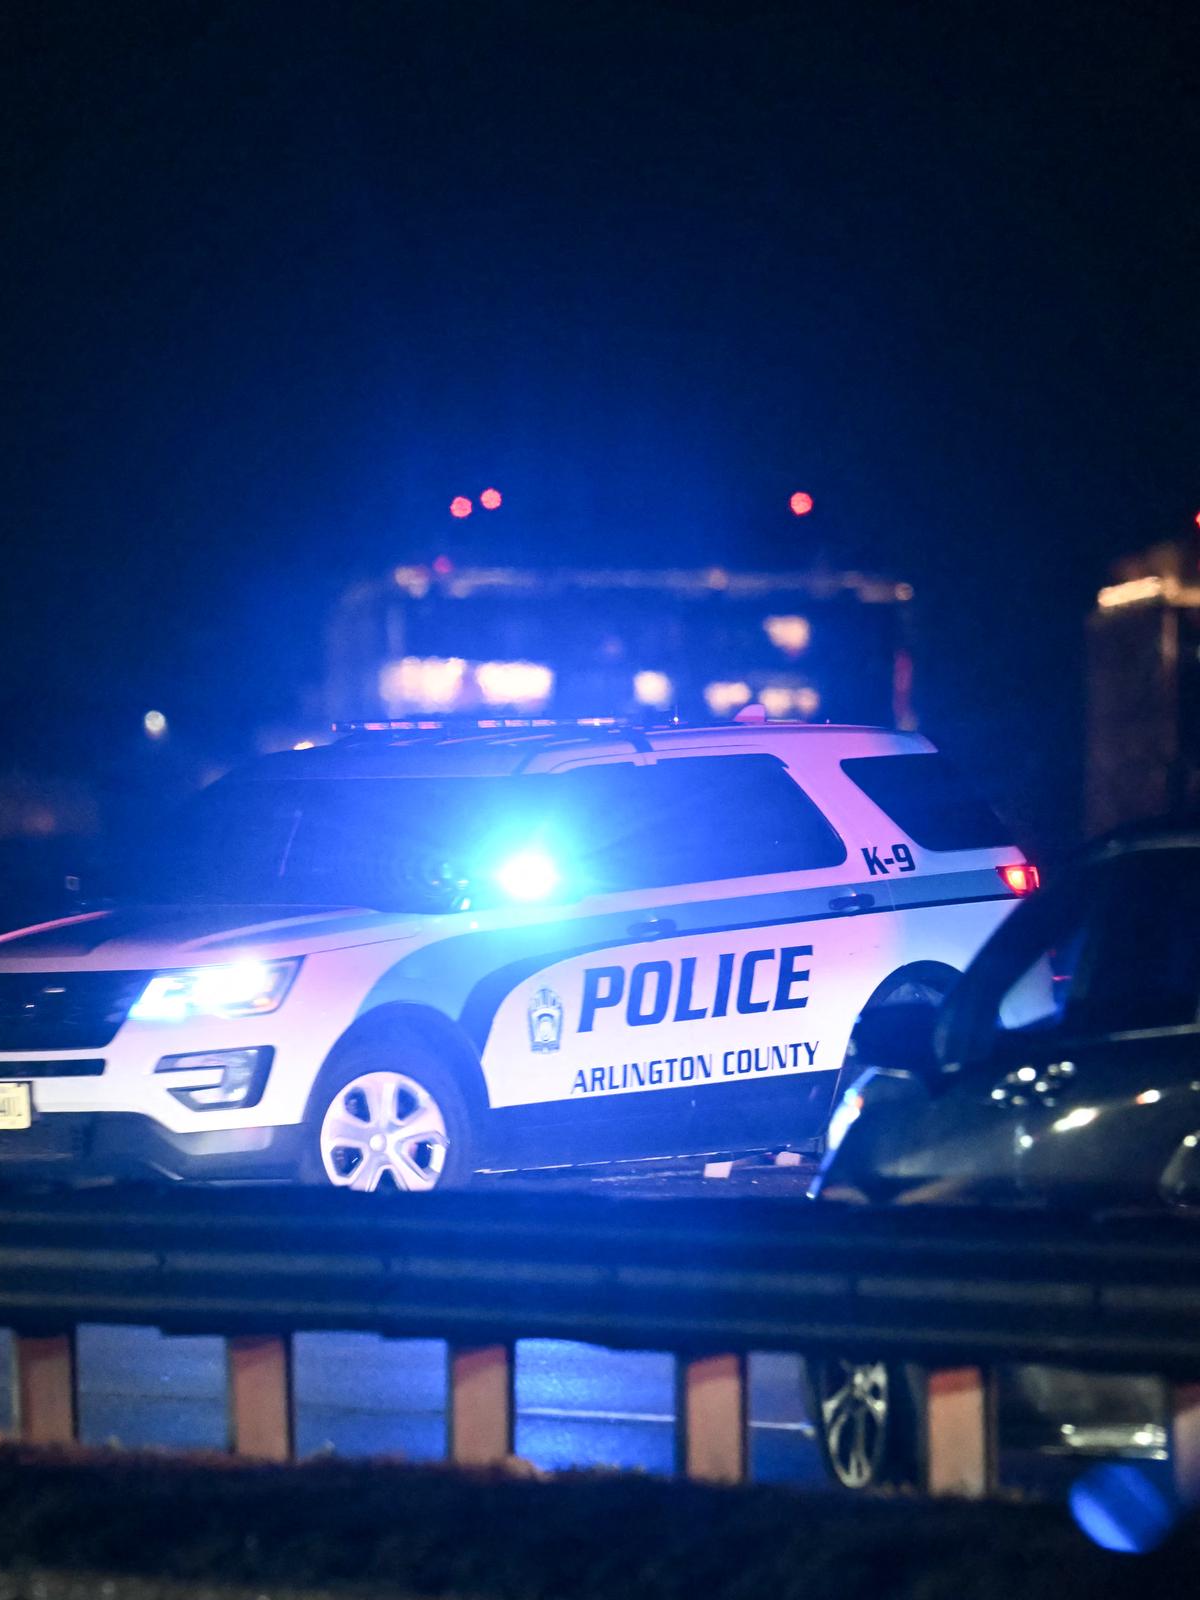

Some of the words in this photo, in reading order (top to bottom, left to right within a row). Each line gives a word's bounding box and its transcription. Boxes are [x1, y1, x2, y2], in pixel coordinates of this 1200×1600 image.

[861, 843, 916, 876] K-9
[576, 944, 814, 1034] POLICE
[571, 1053, 712, 1095] ARLINGTON
[723, 1041, 820, 1076] COUNTY
